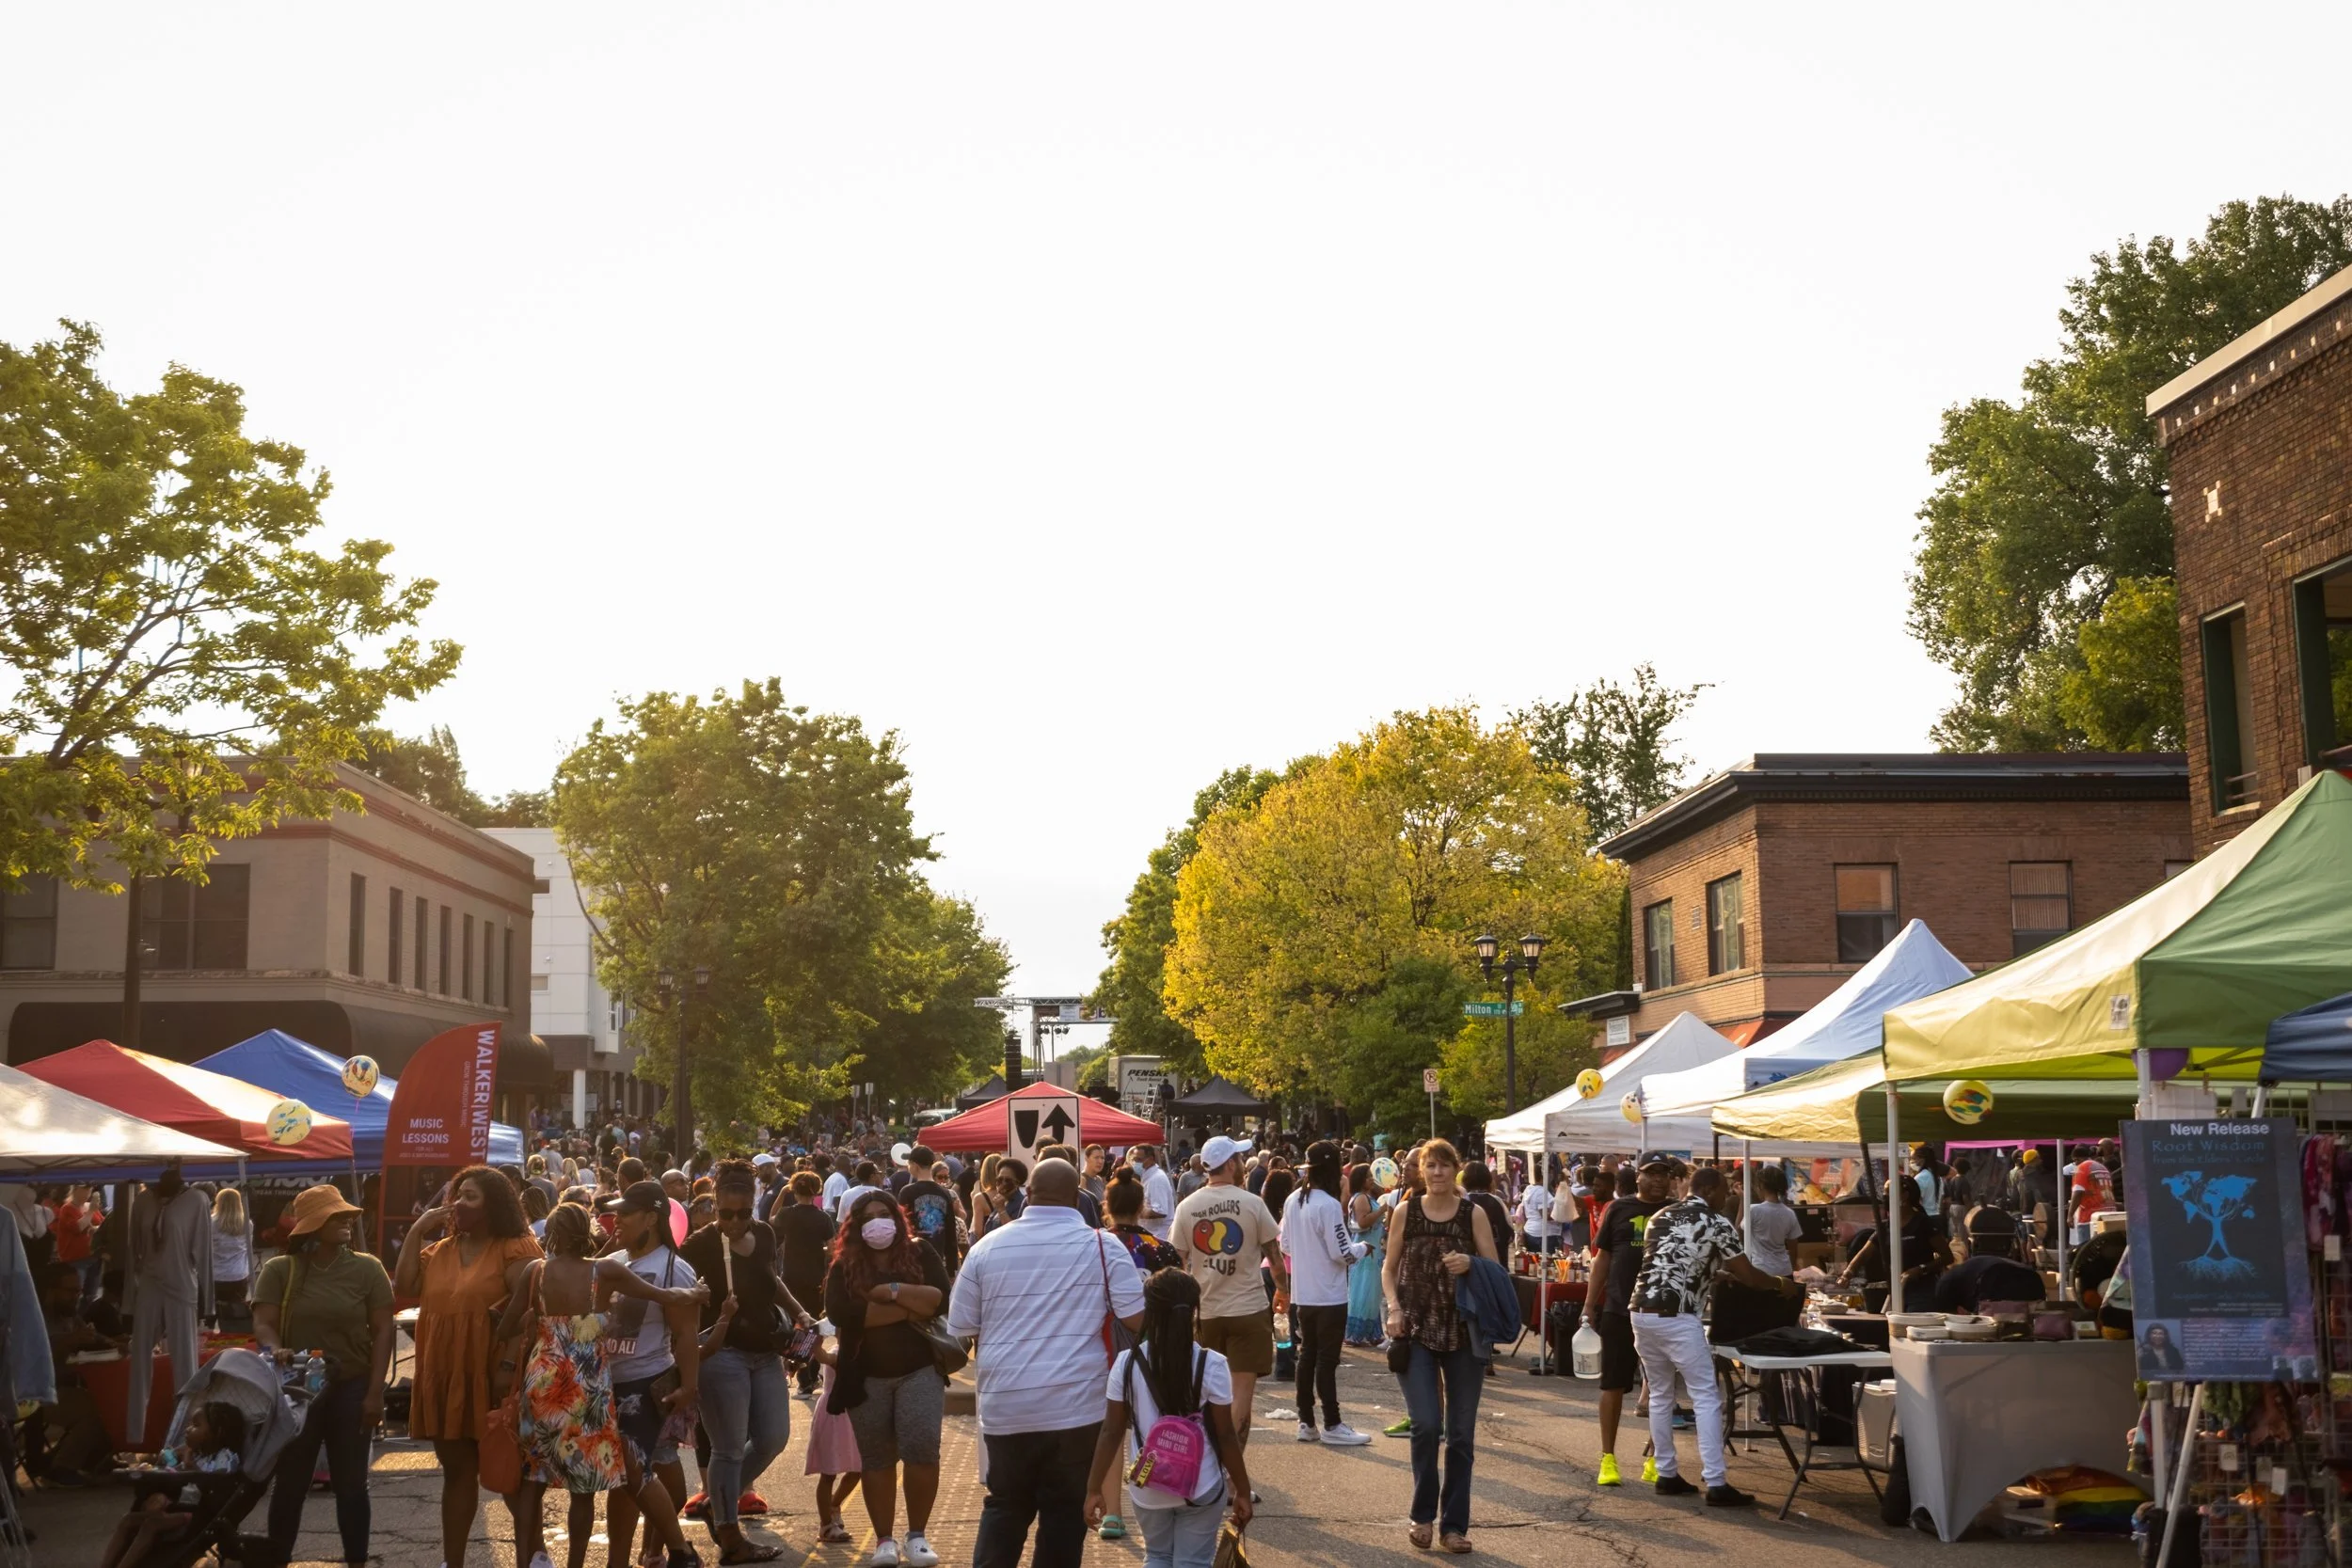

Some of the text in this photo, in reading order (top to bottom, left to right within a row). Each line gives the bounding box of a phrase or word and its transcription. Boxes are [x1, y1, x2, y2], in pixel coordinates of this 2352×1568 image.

[1465, 1004, 1491, 1014] Milton
[409, 1118, 443, 1129] MUSIC
[2170, 1122, 2270, 1136] New Release
[402, 1133, 449, 1144] LESSONS
[2152, 1135, 2265, 1152] Root Wisdom
[2153, 1154, 2176, 1164] from
[1208, 1199, 1241, 1216] ROLLERS
[618, 1339, 636, 1354] ALI
[1161, 1429, 1189, 1445] FASHION
[1156, 1437, 1188, 1454] MINI GIRL
